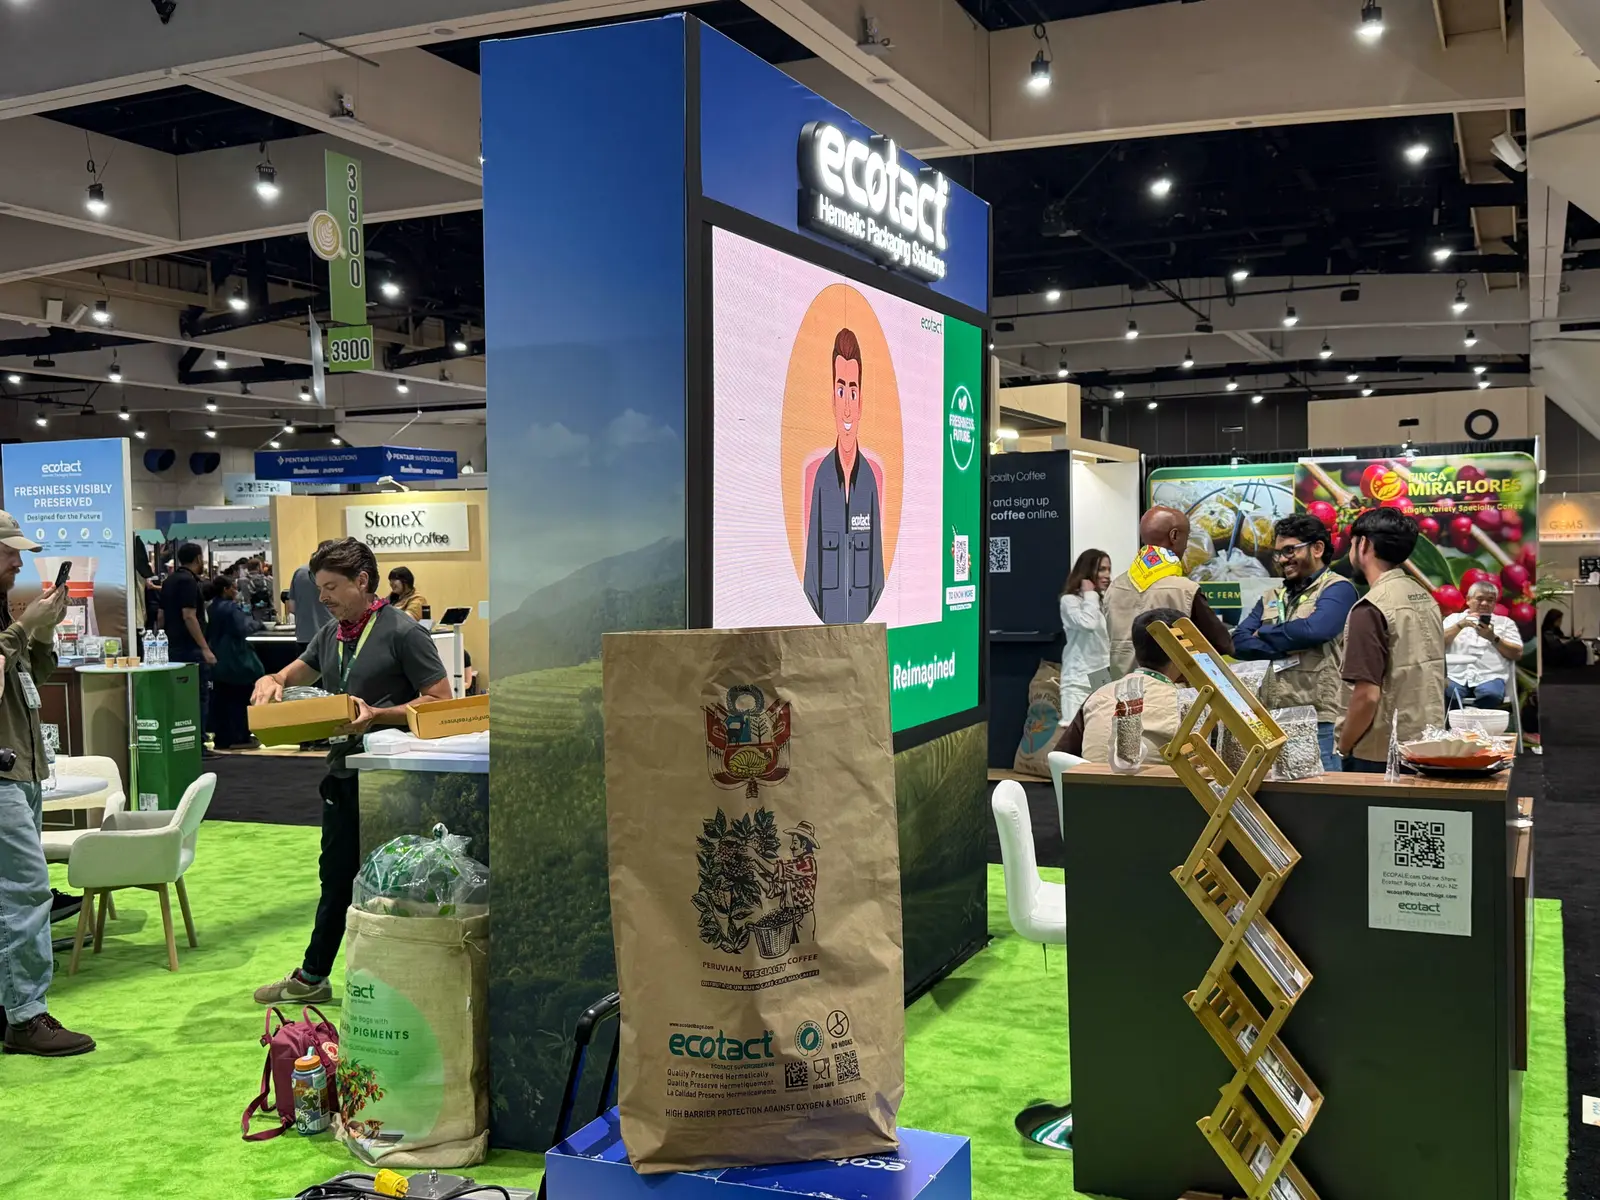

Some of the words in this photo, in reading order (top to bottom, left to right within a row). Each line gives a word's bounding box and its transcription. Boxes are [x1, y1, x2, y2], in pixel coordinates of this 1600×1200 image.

[817, 124, 949, 250] ecotact
[347, 162, 362, 289] 3900
[819, 193, 866, 239] Hermetic
[867, 218, 911, 266] Packaging
[911, 239, 947, 279] Solutions
[331, 338, 371, 363] 3900
[41, 460, 82, 473] ecotact
[1016, 470, 1046, 481] Coffee
[1408, 472, 1446, 481] FINCA
[14, 484, 71, 497] FRESHNESS
[73, 484, 112, 495] VISIBLY
[1408, 479, 1521, 496] MIRAFLORES
[34, 497, 93, 508] PRESERVED
[993, 497, 1012, 507] and
[1013, 496, 1034, 508] sign
[1036, 497, 1050, 507] up
[990, 510, 1026, 520] coffee
[1027, 509, 1059, 519] online.
[1428, 505, 1456, 514] Variety
[1458, 504, 1495, 513] Specialty
[26, 514, 55, 522] Designed
[79, 512, 100, 520] Future
[365, 510, 425, 528] StoneX
[366, 533, 413, 547] Specialty
[414, 532, 449, 545] Coffee
[893, 651, 956, 690] Reimagined
[1398, 901, 1441, 913] ecotact
[702, 961, 742, 973] PERUVIAN
[743, 962, 787, 979] SPECIALTY
[787, 953, 819, 965] COFFEE
[353, 1026, 409, 1040] PIGMENTS
[669, 1029, 774, 1061] ecotact
[667, 1068, 689, 1078] Quality
[690, 1070, 724, 1080] Preserved
[725, 1070, 769, 1080] Hermetically
[675, 1090, 696, 1098] Calidad
[666, 1108, 682, 1118] HIGH
[683, 1109, 716, 1118] BARRIER
[717, 1107, 763, 1117] PROTECTION
[764, 1103, 795, 1114] AGAINST
[796, 1100, 824, 1111] OXYGEN
[825, 1100, 831, 1108] &
[832, 1093, 867, 1107] MOISTURE
